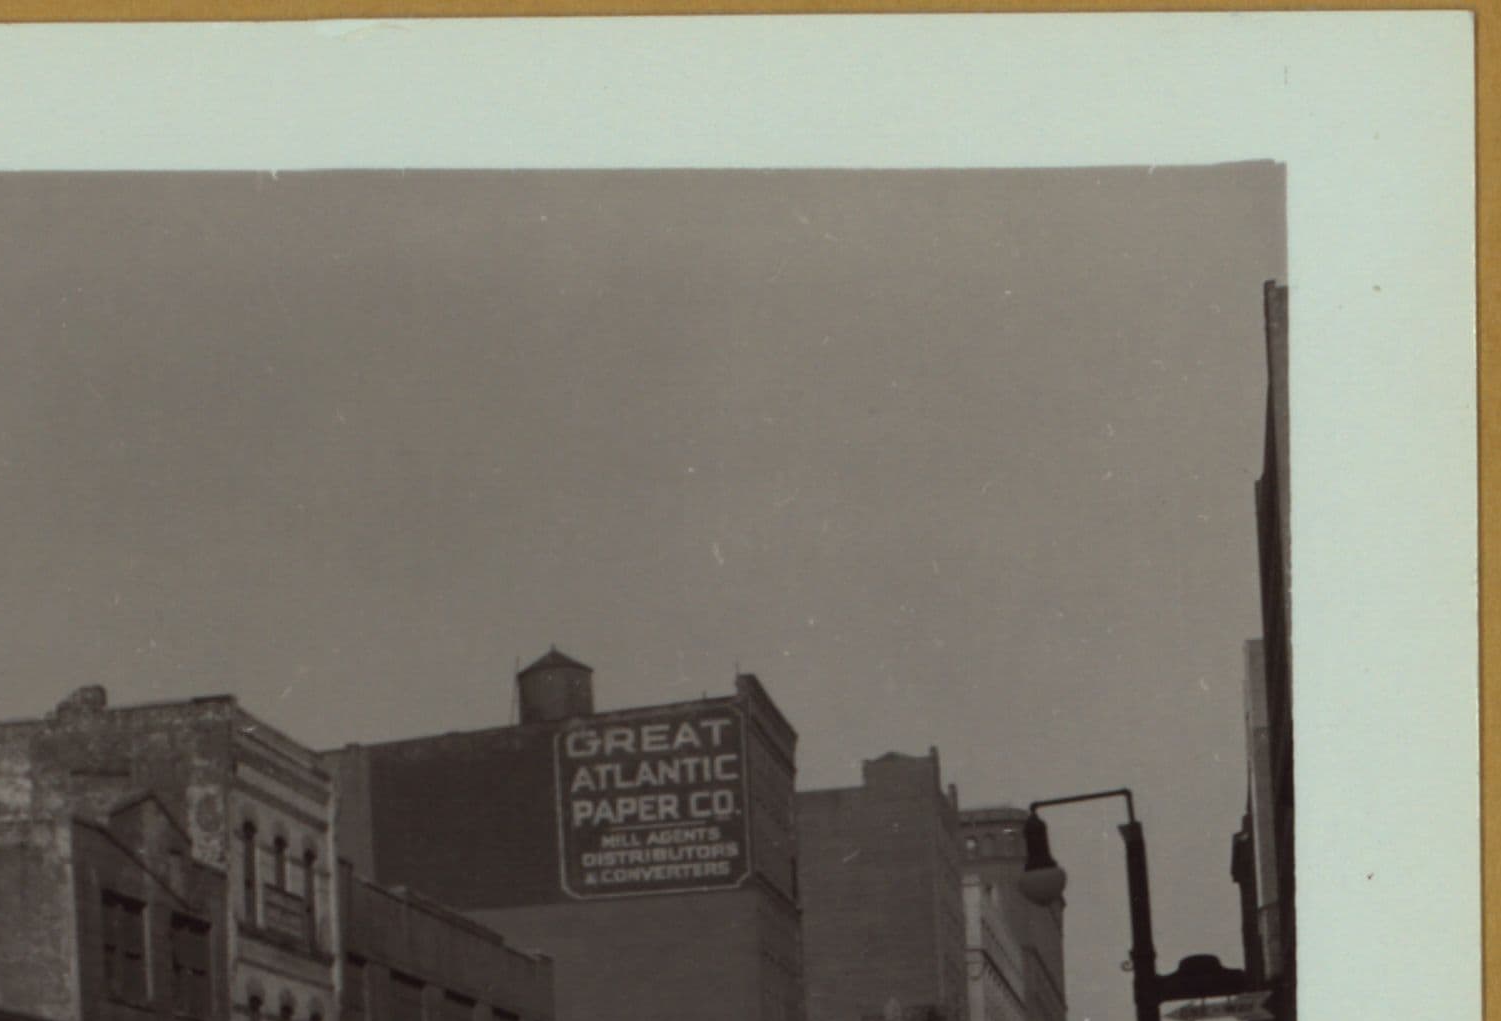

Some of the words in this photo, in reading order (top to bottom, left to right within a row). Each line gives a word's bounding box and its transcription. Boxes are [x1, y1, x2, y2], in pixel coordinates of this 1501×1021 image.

[566, 719, 732, 758] GREAT
[571, 753, 739, 793] ATLANTIC
[572, 794, 680, 827] PAPER
[690, 789, 742, 818] CO.
[601, 833, 641, 849] MILL
[646, 826, 721, 846] AGENTS
[581, 841, 740, 868] DISTRIBUTORS
[601, 861, 731, 884] CONVERTERS
